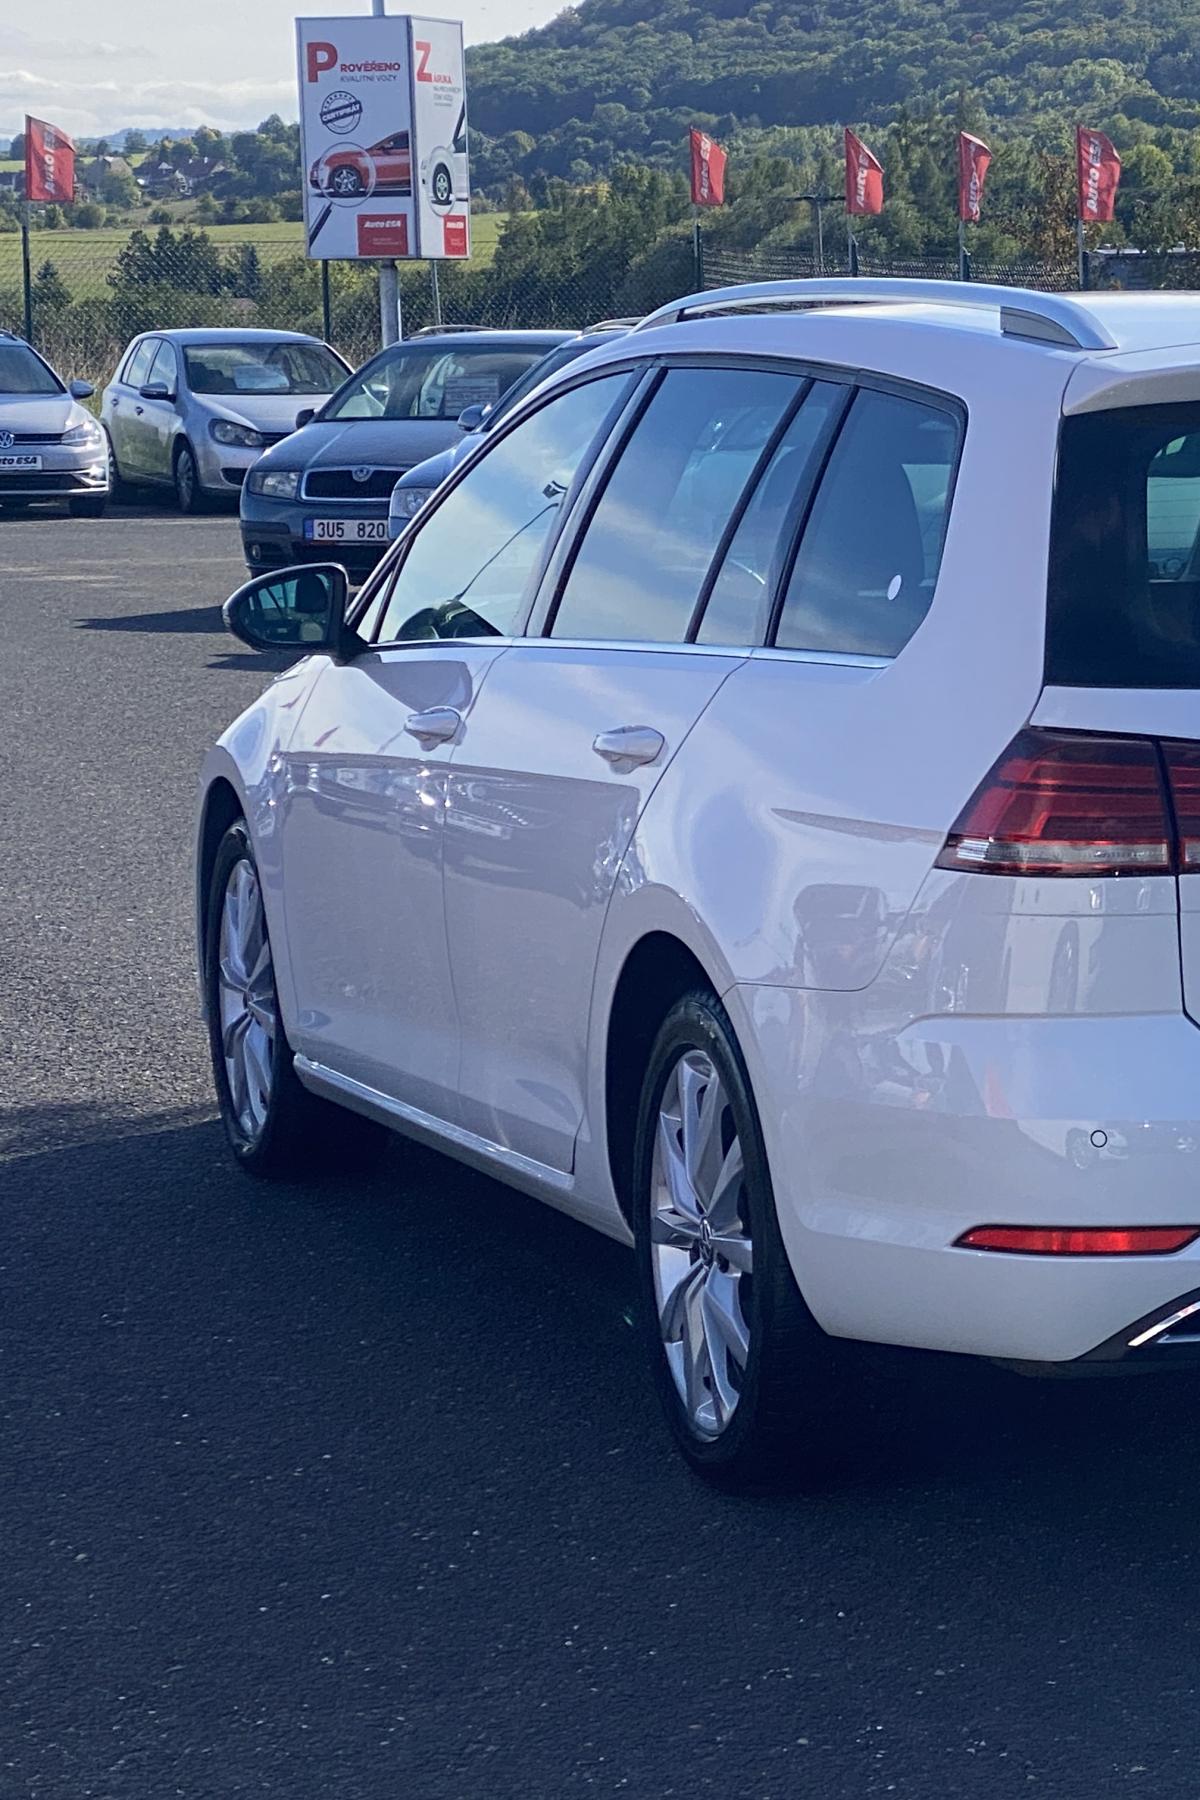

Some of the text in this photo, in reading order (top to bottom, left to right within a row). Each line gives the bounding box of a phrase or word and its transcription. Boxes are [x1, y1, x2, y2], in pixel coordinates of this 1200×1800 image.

[16, 456, 37, 465] ESA
[317, 522, 345, 538] 3U5
[357, 522, 386, 538] 820
